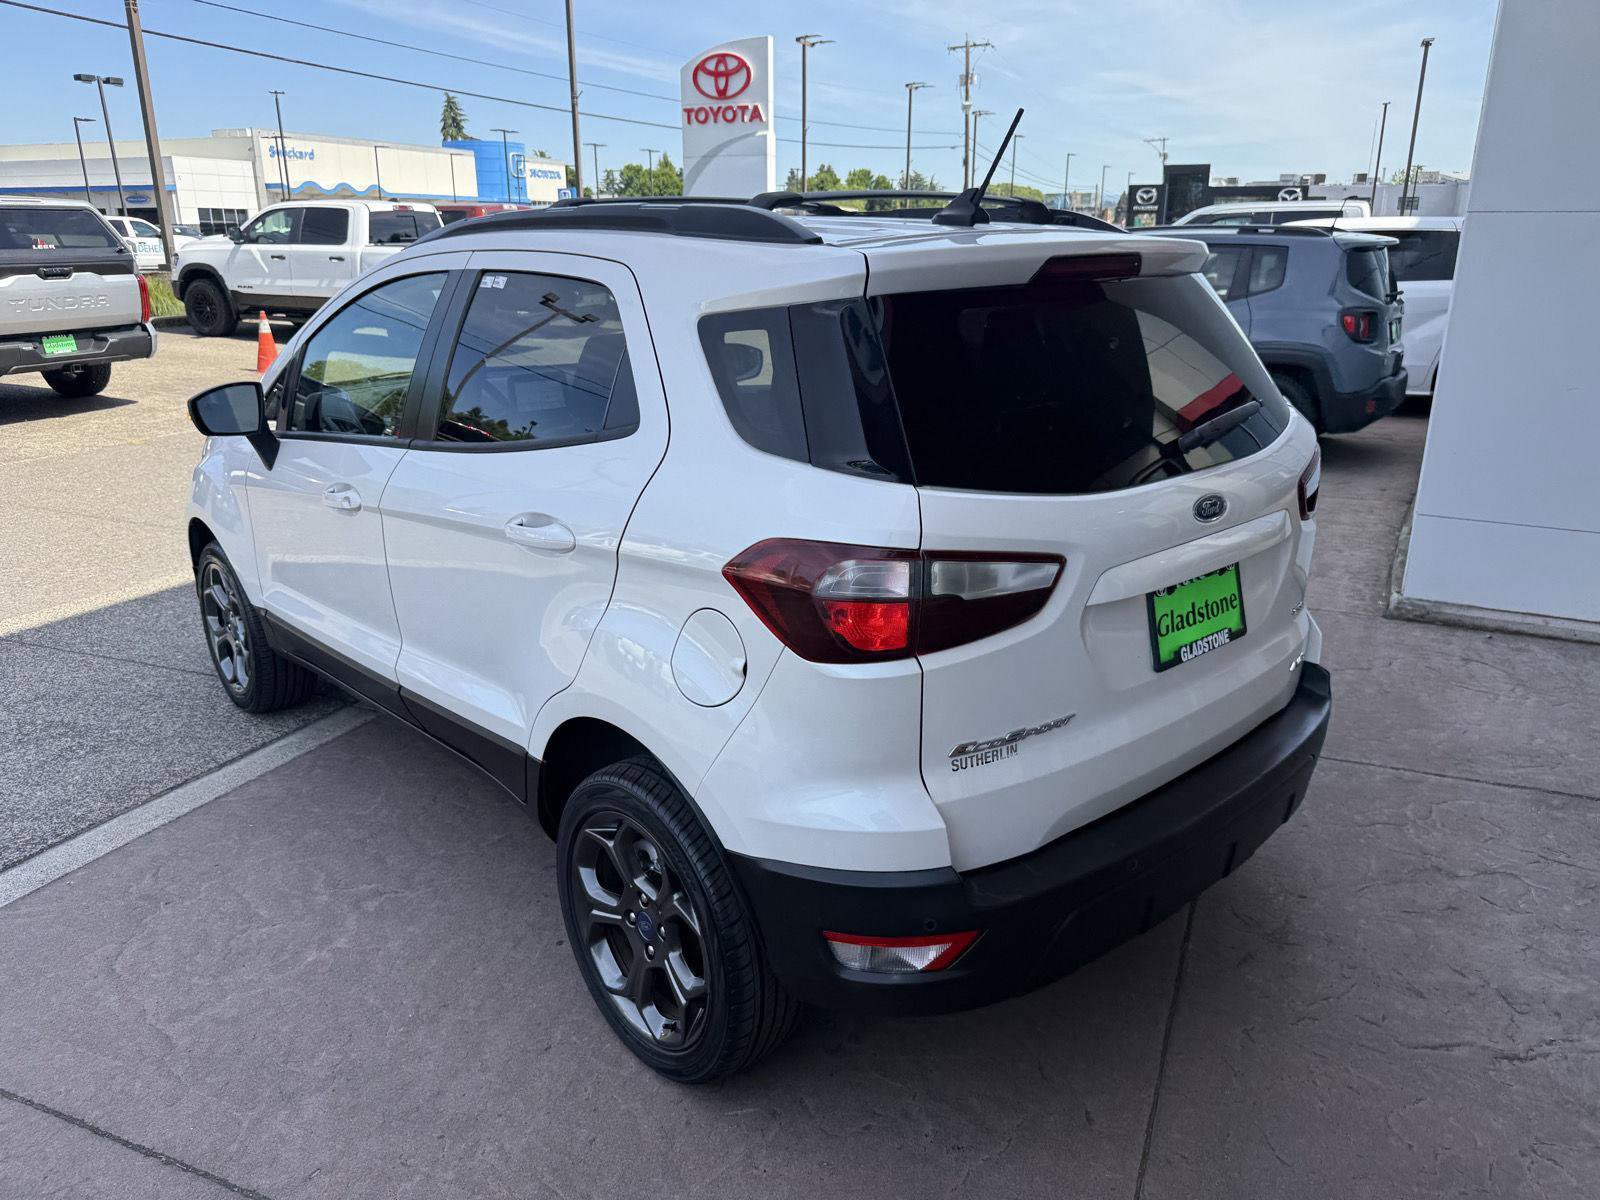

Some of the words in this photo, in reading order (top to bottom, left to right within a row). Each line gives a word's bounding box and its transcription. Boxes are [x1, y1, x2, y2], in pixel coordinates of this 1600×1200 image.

[683, 104, 764, 125] TOYOTA
[268, 144, 315, 161] Sckard
[8, 295, 110, 313] TUNDRA
[1157, 592, 1238, 638] Gladstone
[1180, 628, 1231, 662] GLADSTONE
[951, 743, 1019, 772] SUTHERLIN
